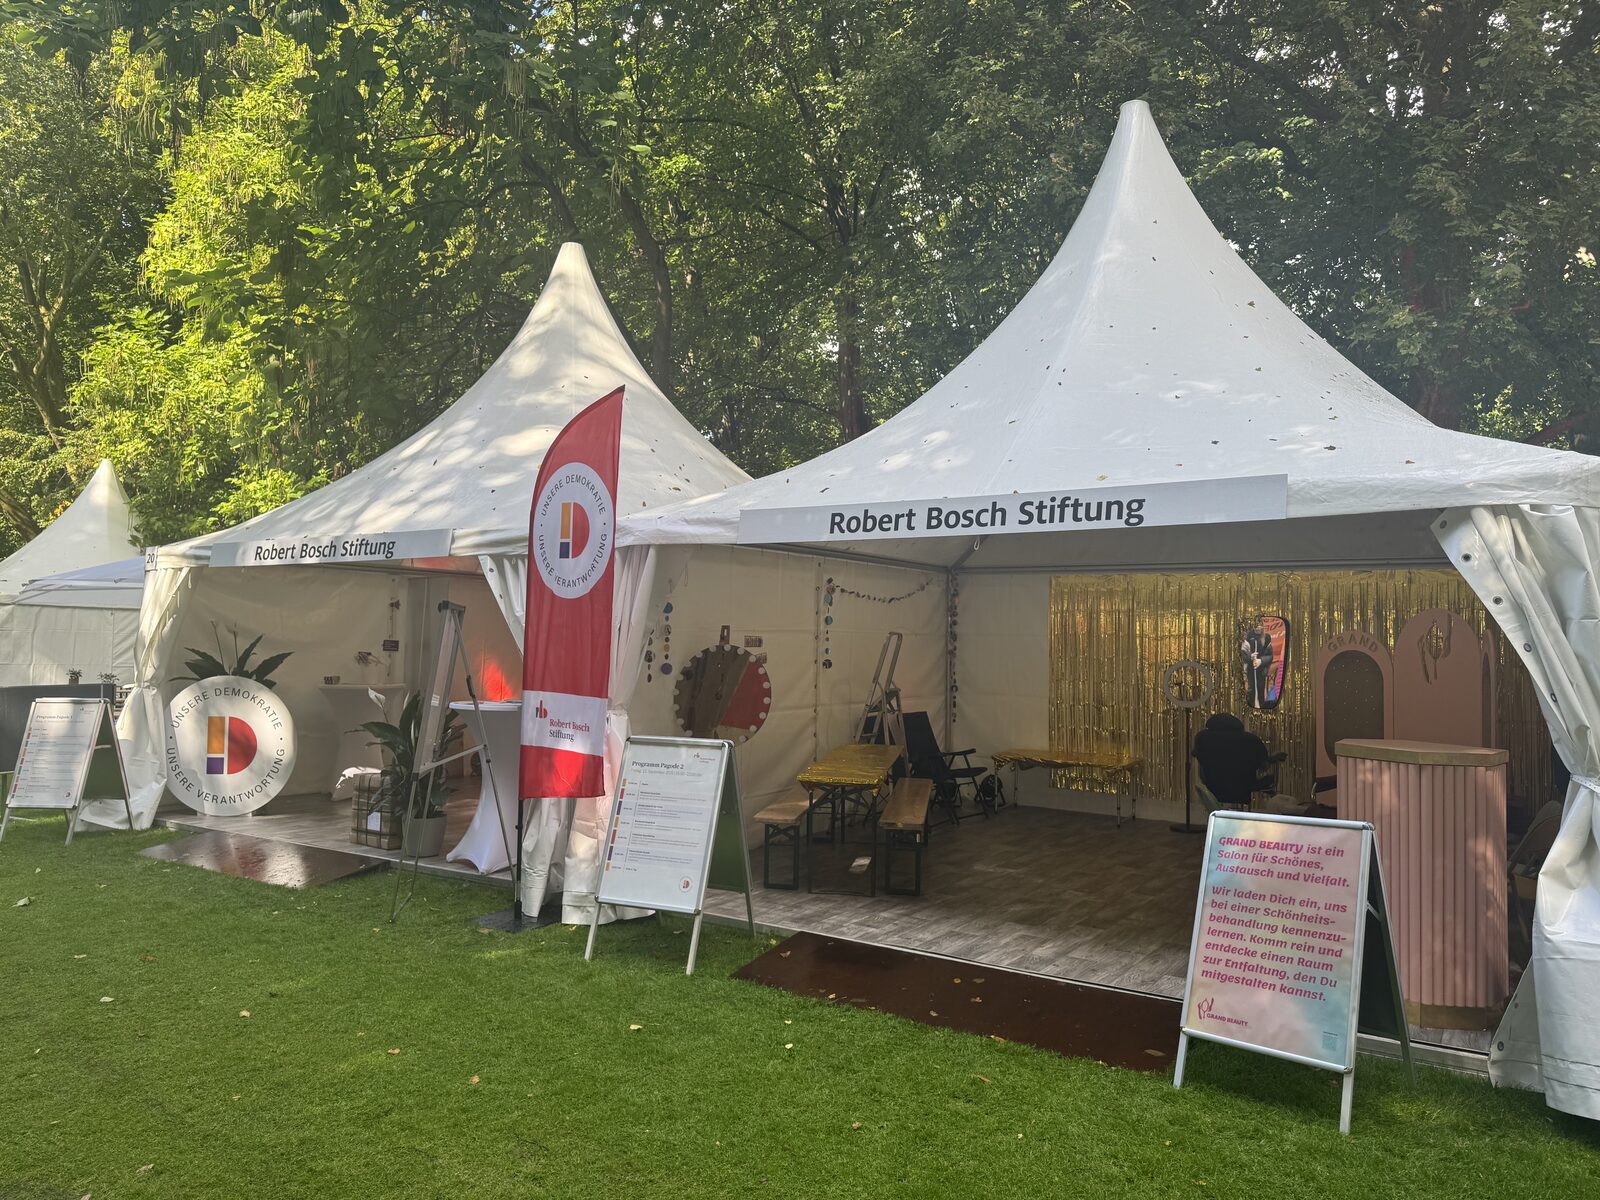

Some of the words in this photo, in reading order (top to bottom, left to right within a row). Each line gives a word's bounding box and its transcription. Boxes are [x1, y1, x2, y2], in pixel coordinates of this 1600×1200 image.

[541, 479, 564, 517] UNSERE
[565, 474, 606, 515] DEMOKRATIE
[829, 508, 917, 535] Robert
[926, 501, 1007, 530] Bosch
[1018, 496, 1146, 527] Stiftung
[146, 552, 155, 564] 20
[254, 544, 296, 562] Robert
[299, 541, 337, 559] Bosch
[340, 538, 396, 559] Stiftung
[538, 534, 555, 577] UNSERE
[1327, 633, 1378, 653] GRAND
[171, 690, 210, 730] UNSERE
[214, 687, 283, 730] DEMOKRATIE
[549, 718, 571, 729] Robert
[572, 721, 590, 733] Bosch
[549, 729, 575, 743] Stiftung
[166, 747, 195, 793] UNSERE
[196, 748, 285, 805] VERANTWORTUNG
[632, 760, 660, 769] Programm
[1217, 850, 1249, 861] Salon
[1251, 853, 1268, 865] für
[1270, 855, 1324, 871] Schönes,
[1218, 836, 1257, 848] GRAND
[1259, 840, 1304, 854] BEAUTY
[1306, 843, 1322, 855] ist
[1325, 846, 1344, 857] ein
[1216, 863, 1276, 879] Austausch
[1277, 870, 1300, 881] und
[1303, 873, 1350, 888] Vielfalt.
[1211, 899, 1228, 910] bei
[1231, 902, 1261, 915] einer
[1263, 907, 1336, 927] Schönheits-
[1212, 885, 1231, 896] Wir
[1234, 888, 1266, 902] laden
[1269, 893, 1296, 906] Dich
[1299, 899, 1320, 911] ein,
[1324, 902, 1348, 913] uns
[1209, 912, 1278, 934] behandlung
[1281, 924, 1347, 943] kennenzu-
[1207, 926, 1247, 942] lernen.
[1249, 934, 1288, 949] Komm
[1290, 941, 1315, 953] rein
[1318, 945, 1343, 958] und
[1205, 941, 1257, 958] entdecke
[1260, 950, 1294, 965] einen
[1297, 957, 1334, 972] Raum
[1201, 968, 1277, 992] mitgestalten
[1279, 983, 1326, 1002] kannst.
[1203, 955, 1222, 965] zur
[1224, 958, 1290, 981] Entfaltung,
[1293, 971, 1317, 984] den
[1320, 976, 1337, 988] Du
[1206, 1012, 1226, 1022] GRAND
[1226, 1017, 1249, 1027] BEAUTY
